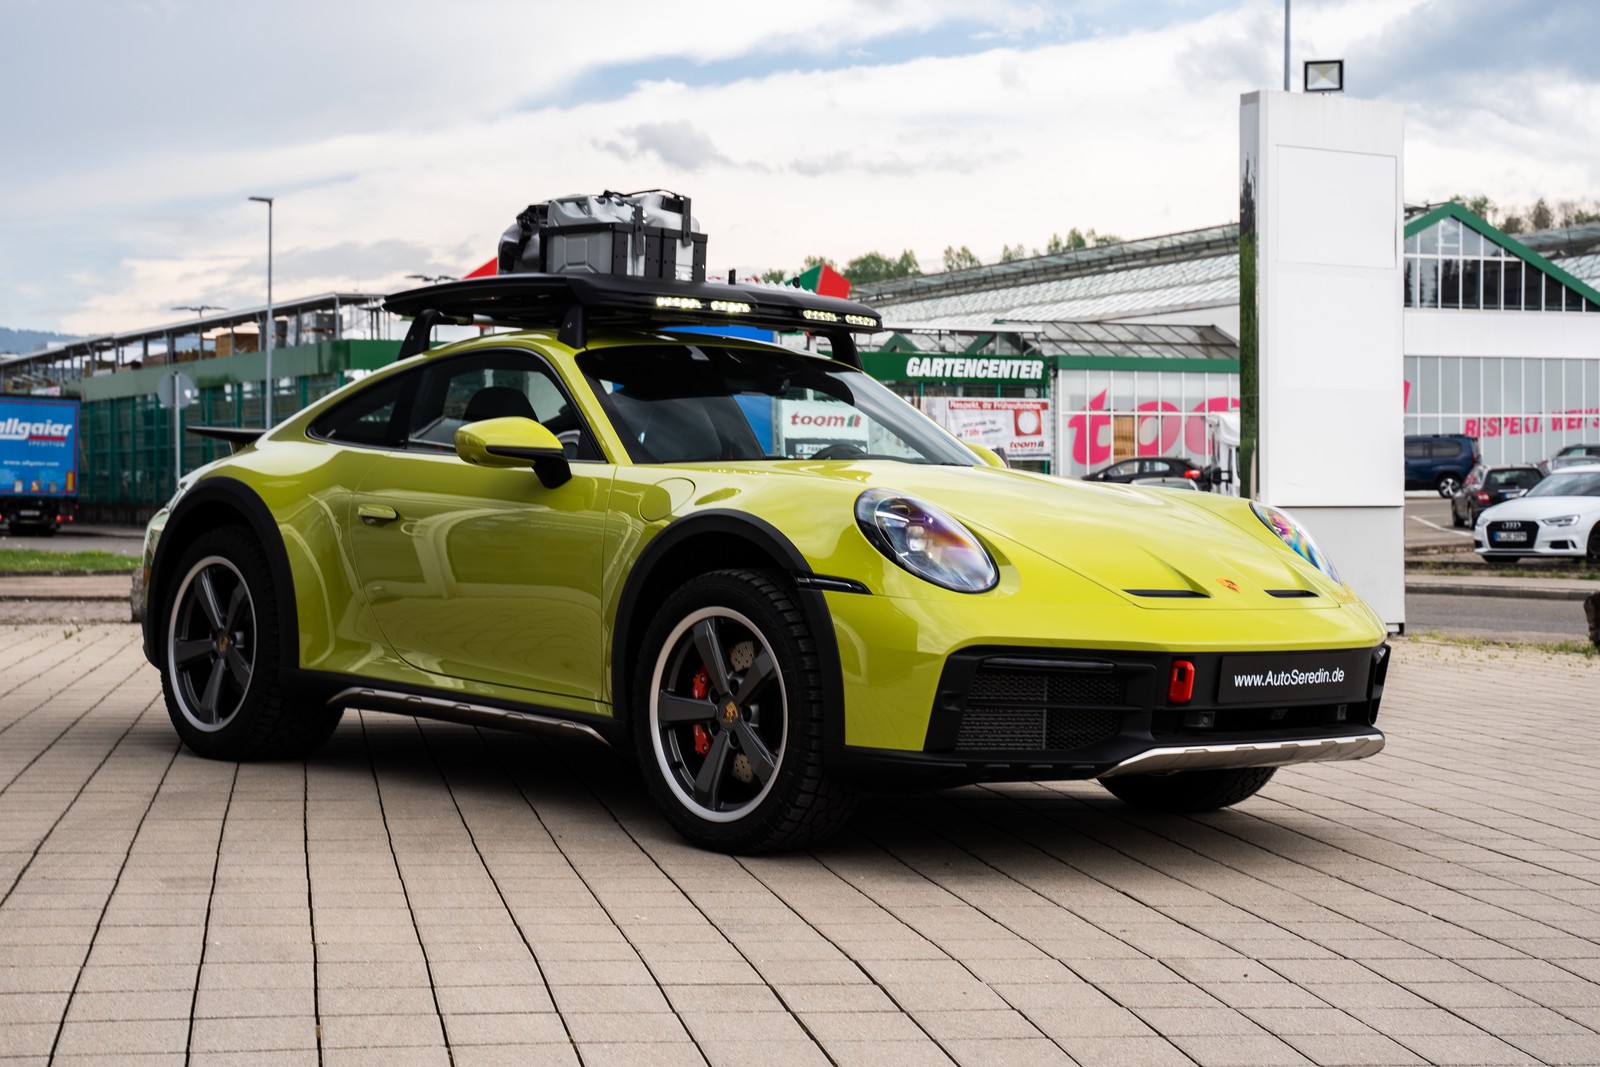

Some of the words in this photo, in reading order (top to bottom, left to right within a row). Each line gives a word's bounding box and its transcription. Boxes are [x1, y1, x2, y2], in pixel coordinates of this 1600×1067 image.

[906, 356, 1044, 381] GARTENCENTER
[949, 400, 981, 410] Respekt,
[790, 411, 846, 427] toom
[970, 428, 981, 436] Uhr
[1009, 440, 1037, 449] toom
[1234, 667, 1345, 688] www.AutoSeredin.de
